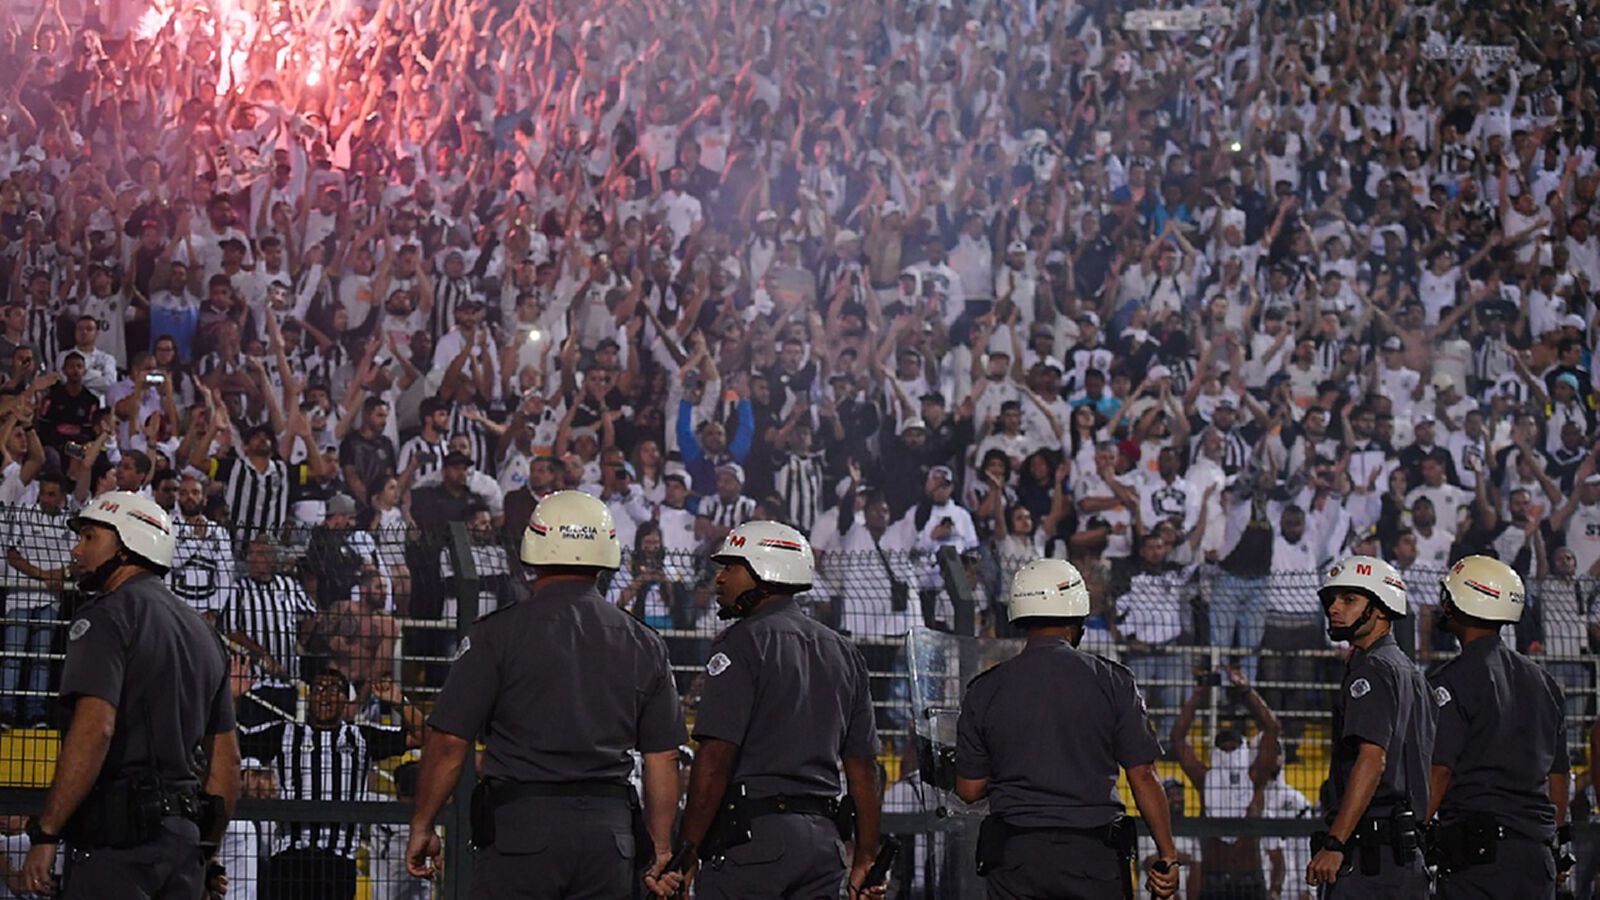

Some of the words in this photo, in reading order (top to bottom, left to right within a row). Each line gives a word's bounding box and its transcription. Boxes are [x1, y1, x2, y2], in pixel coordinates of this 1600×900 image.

[99, 500, 120, 514] M
[729, 535, 747, 548] M
[1356, 563, 1372, 576] M
